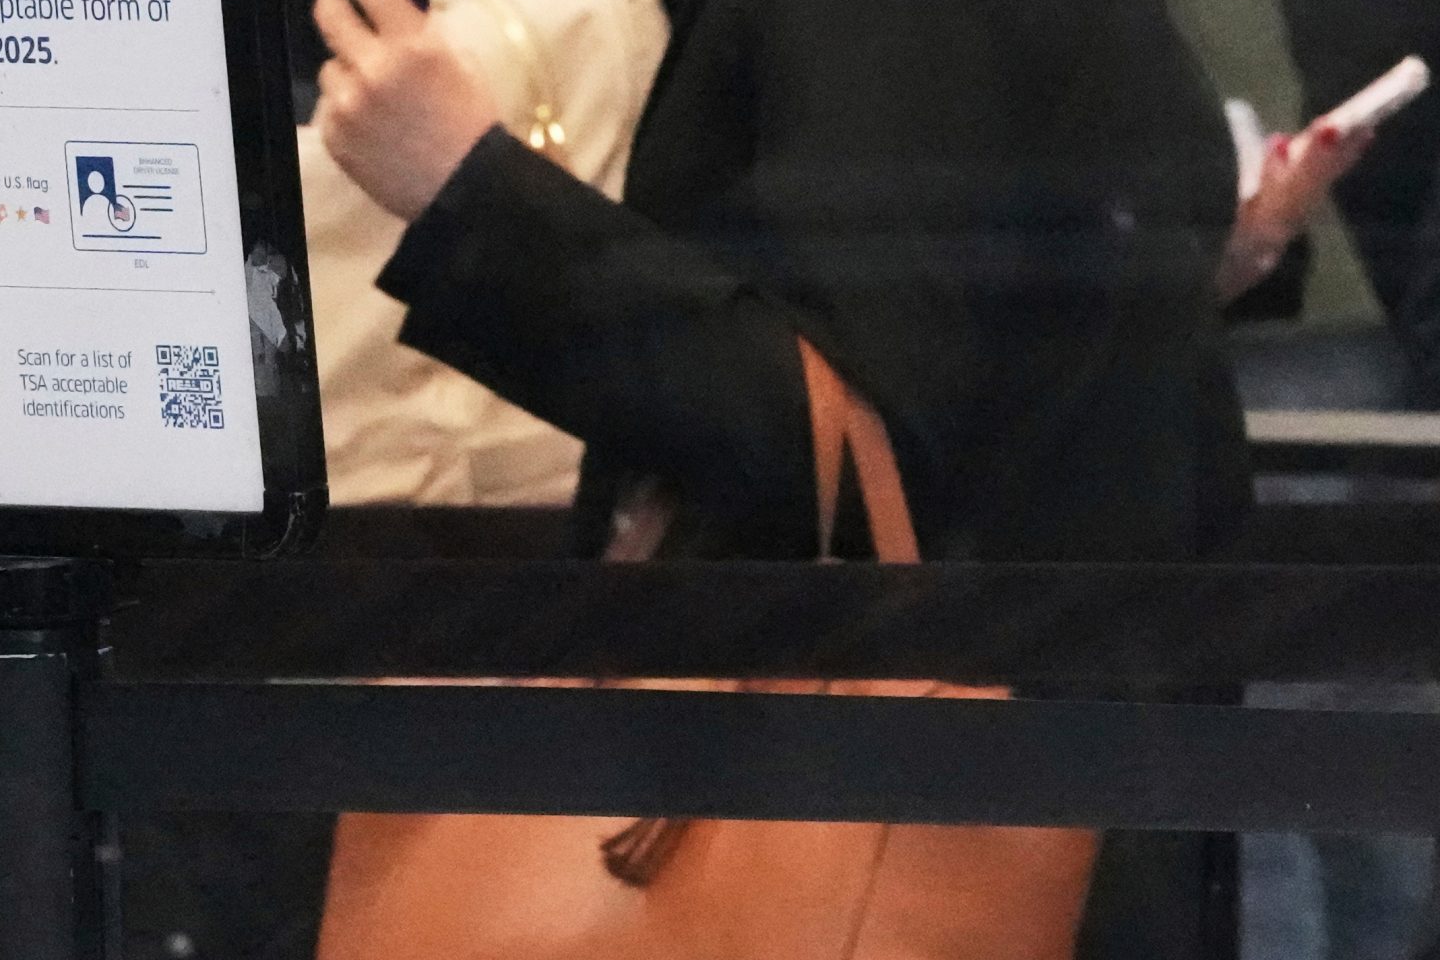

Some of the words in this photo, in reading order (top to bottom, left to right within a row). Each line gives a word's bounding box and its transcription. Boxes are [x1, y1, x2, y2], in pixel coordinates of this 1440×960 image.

[4, 176, 25, 189] U.S.
[135, 259, 150, 268] EDL
[18, 349, 51, 366] Scan
[55, 349, 76, 367] for
[80, 353, 89, 367] a
[93, 350, 114, 368] list
[118, 351, 132, 368] of
[19, 374, 48, 391] TSA
[52, 376, 128, 395] acceptable
[23, 399, 125, 419] identifications
